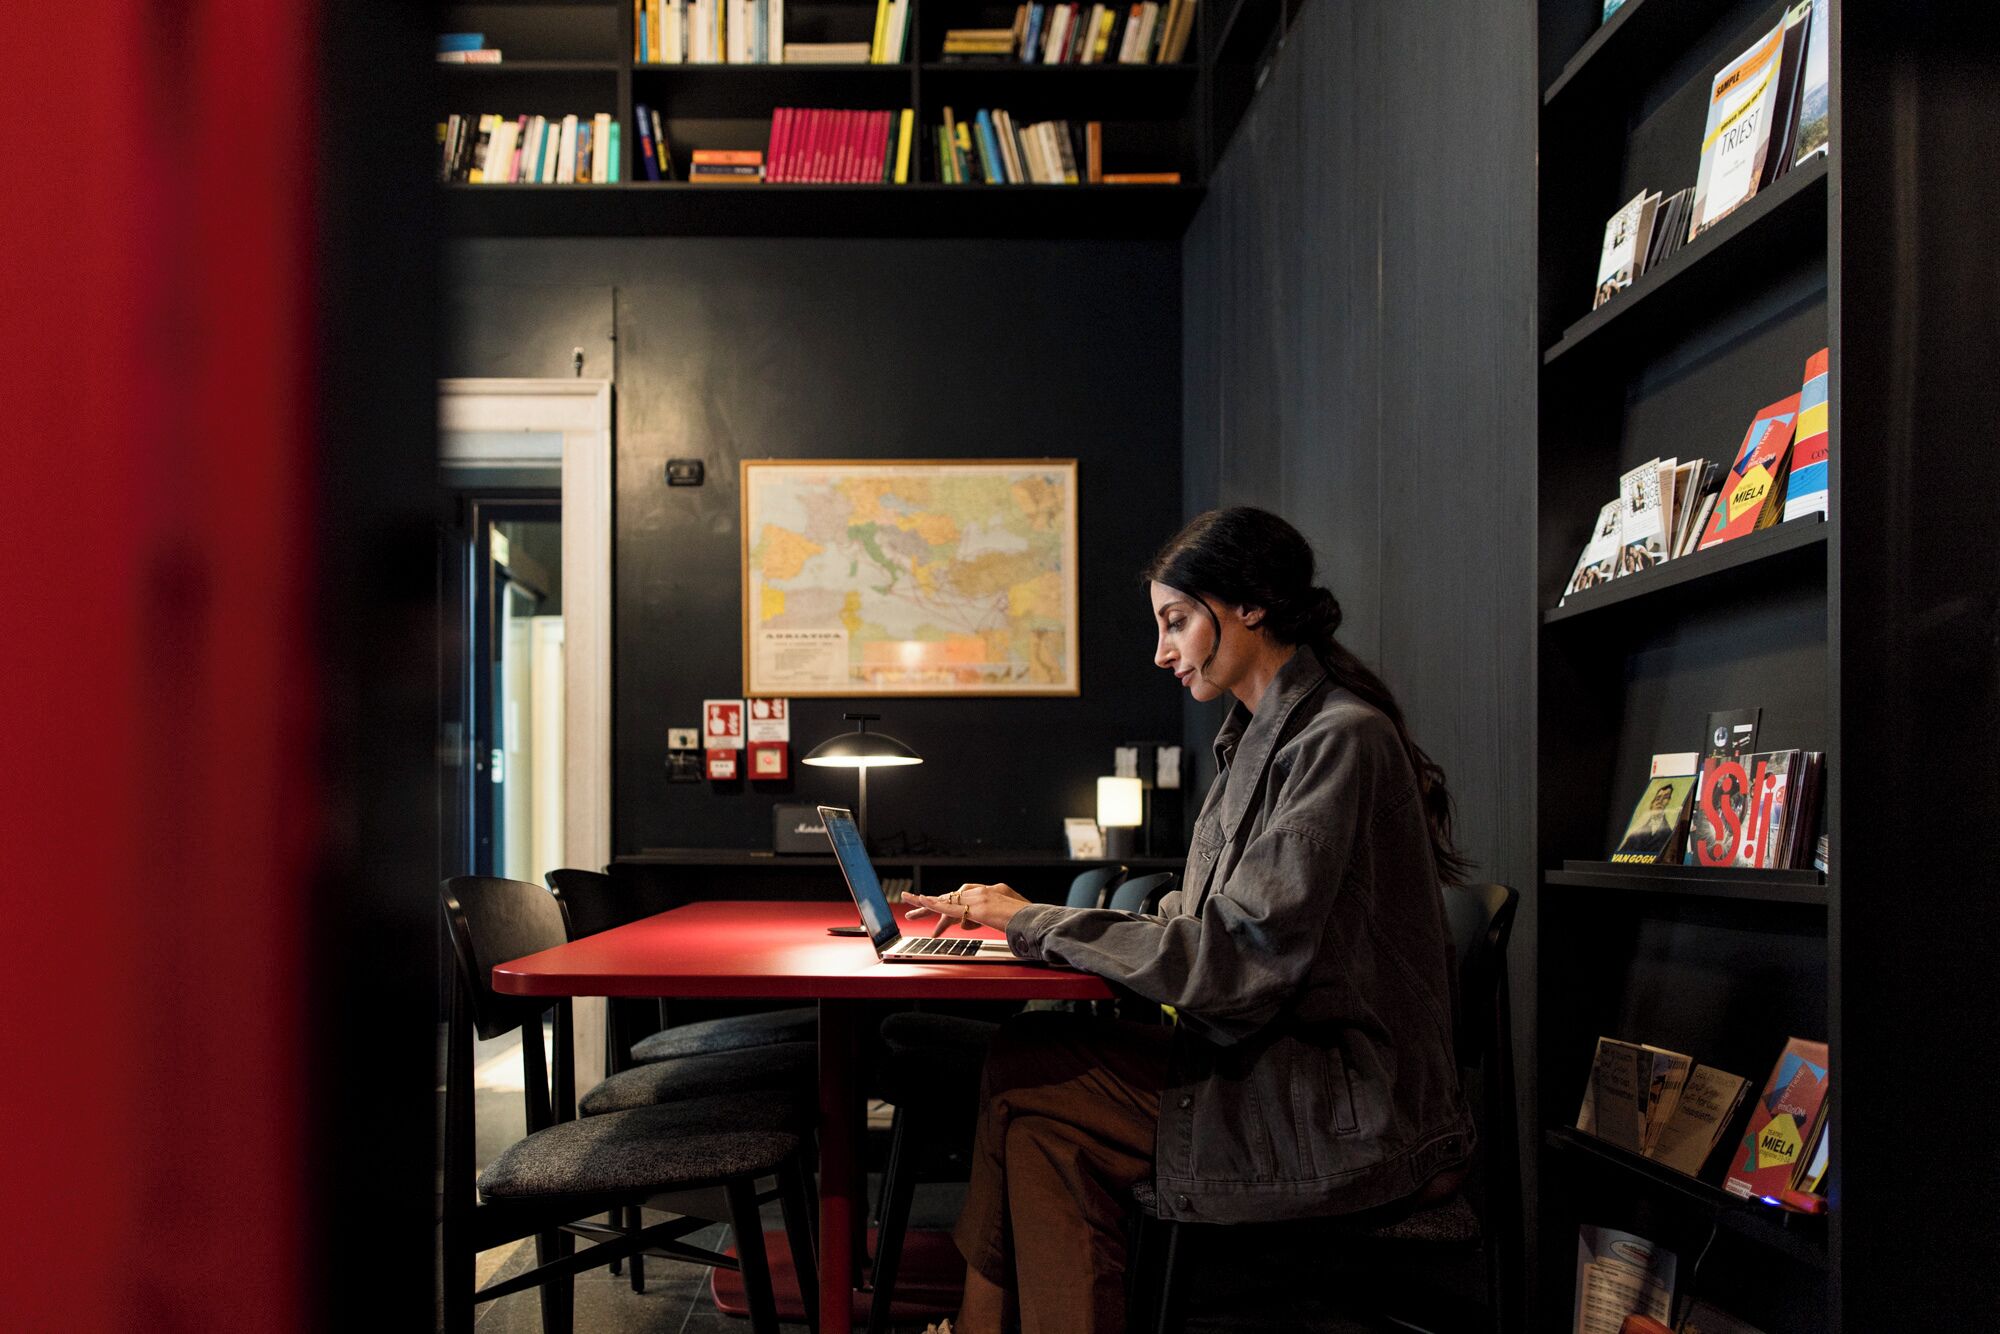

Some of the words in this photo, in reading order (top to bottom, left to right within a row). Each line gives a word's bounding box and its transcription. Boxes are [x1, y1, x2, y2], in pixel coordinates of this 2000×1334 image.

[1716, 71, 1740, 97] SAMPLE
[1721, 108, 1760, 156] TRIEST
[1733, 484, 1764, 504] MIELA
[1611, 853, 1630, 863] VAN
[1629, 854, 1657, 864] GOGH
[1761, 1135, 1794, 1157] MIELA
